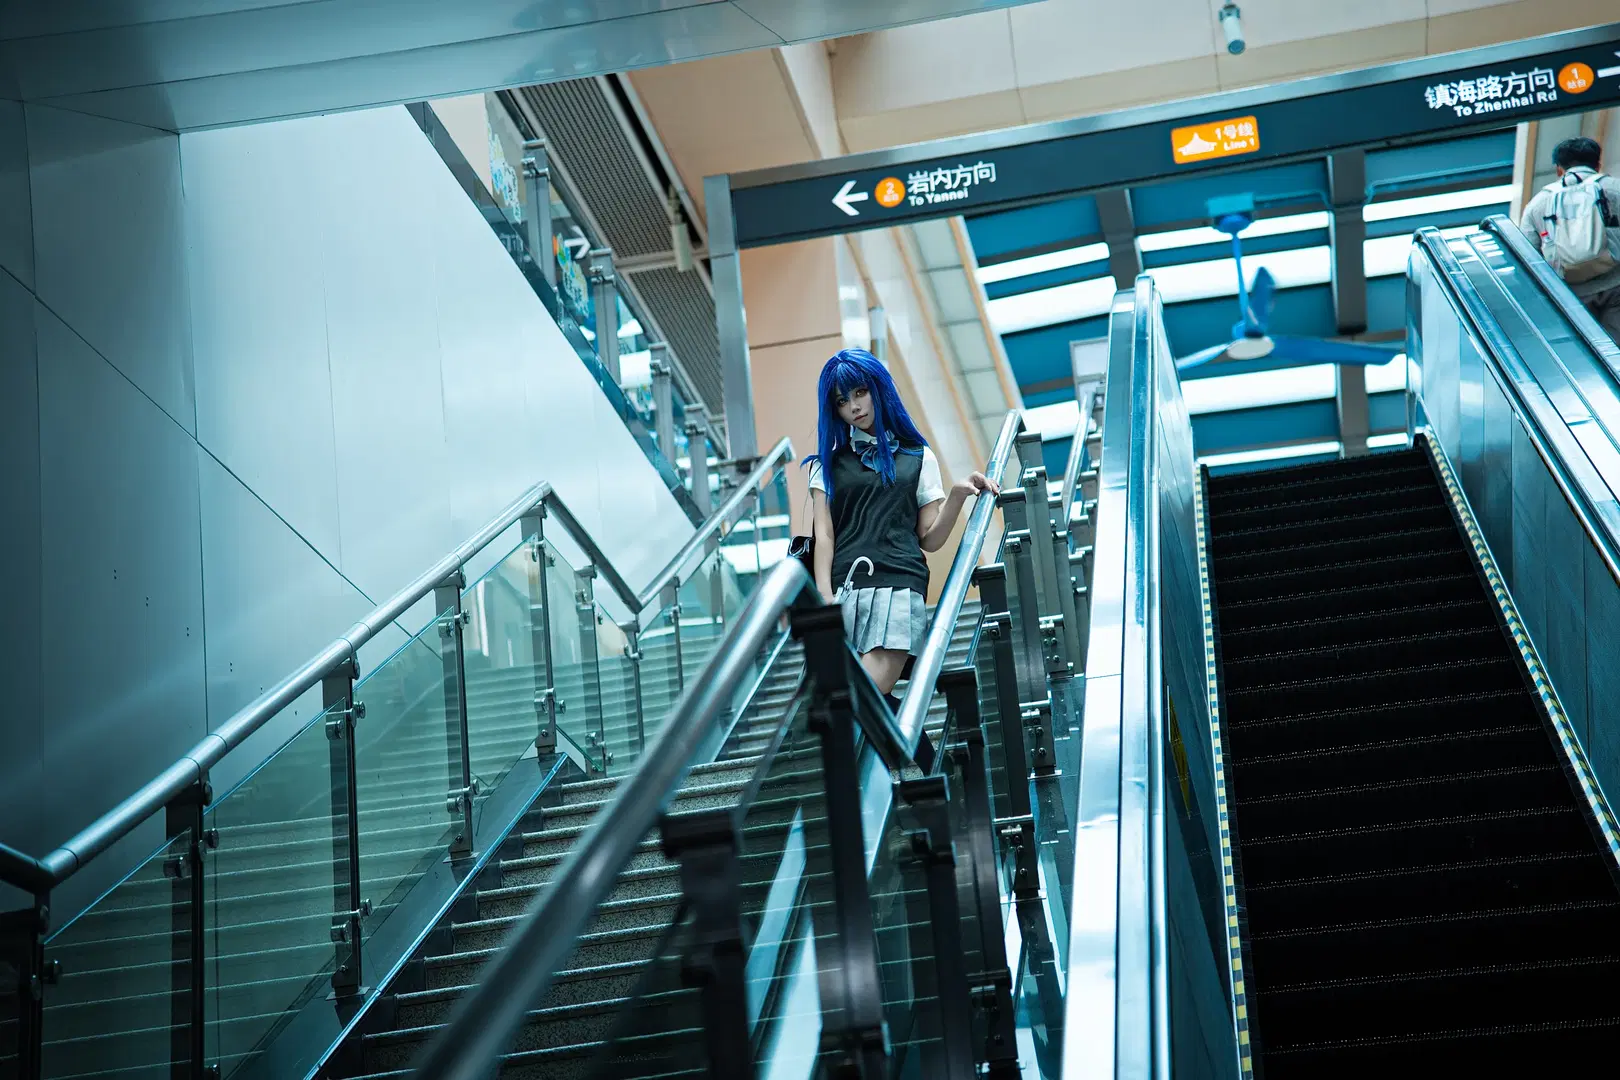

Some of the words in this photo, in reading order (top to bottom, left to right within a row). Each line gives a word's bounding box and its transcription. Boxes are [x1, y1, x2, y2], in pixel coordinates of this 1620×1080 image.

[1570, 67, 1579, 80] 1
[1424, 67, 1555, 109] 镇海路方向
[1453, 105, 1473, 118] To
[1474, 94, 1534, 115] Zhenhai
[1536, 89, 1558, 104] Rd
[1215, 122, 1254, 140] 1号线
[1223, 140, 1247, 151] Line
[907, 161, 997, 194] 岩内方向
[885, 181, 895, 195] 2
[908, 194, 925, 207] To
[925, 187, 969, 204] Yannei
